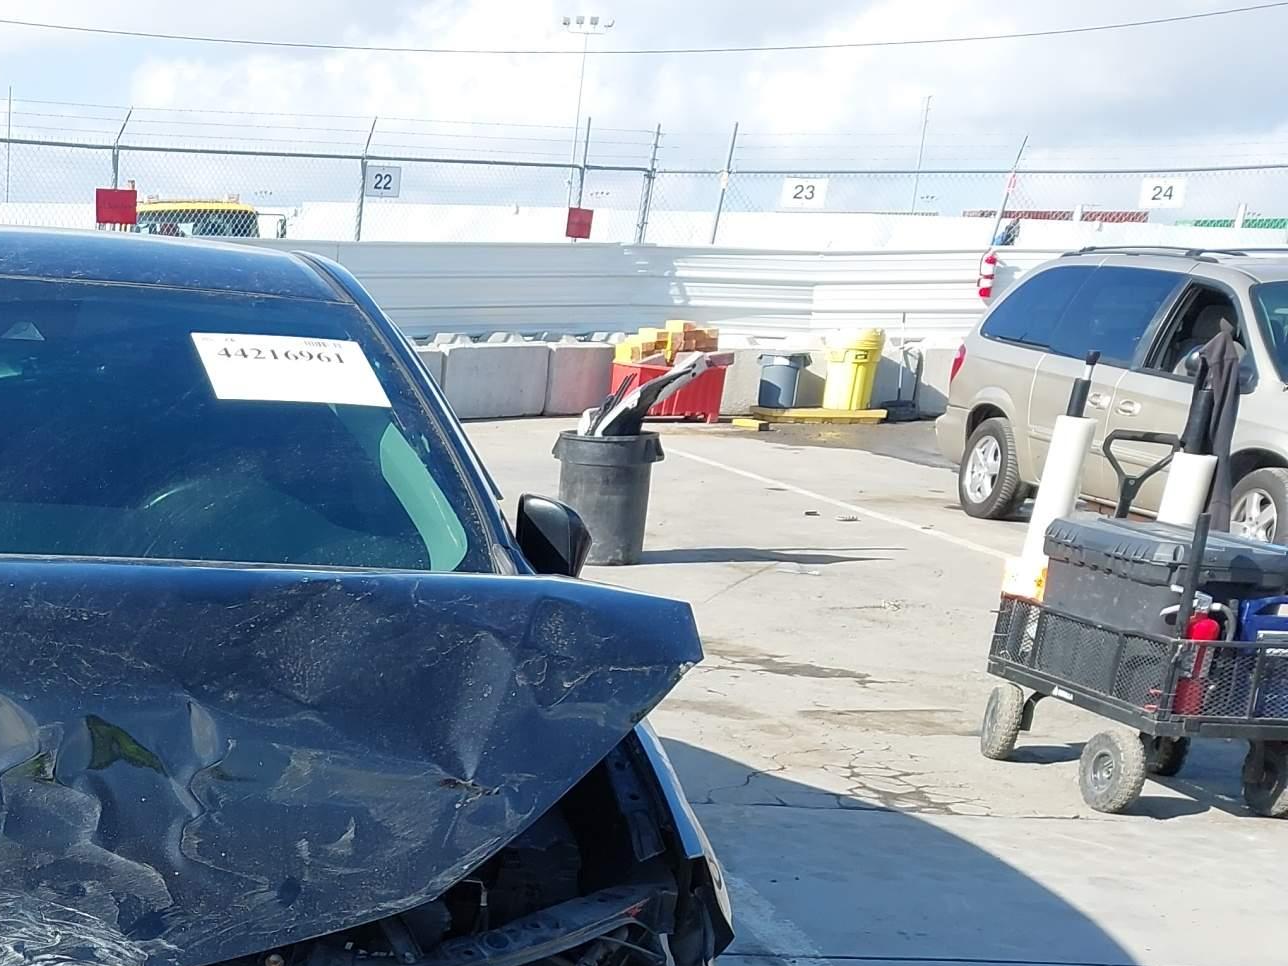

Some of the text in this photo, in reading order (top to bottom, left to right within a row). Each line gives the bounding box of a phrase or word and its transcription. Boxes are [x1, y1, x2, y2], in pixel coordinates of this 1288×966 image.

[373, 173, 393, 190] 22
[792, 184, 816, 200] 23
[1151, 185, 1174, 201] 24
[217, 346, 346, 365] 44216961
